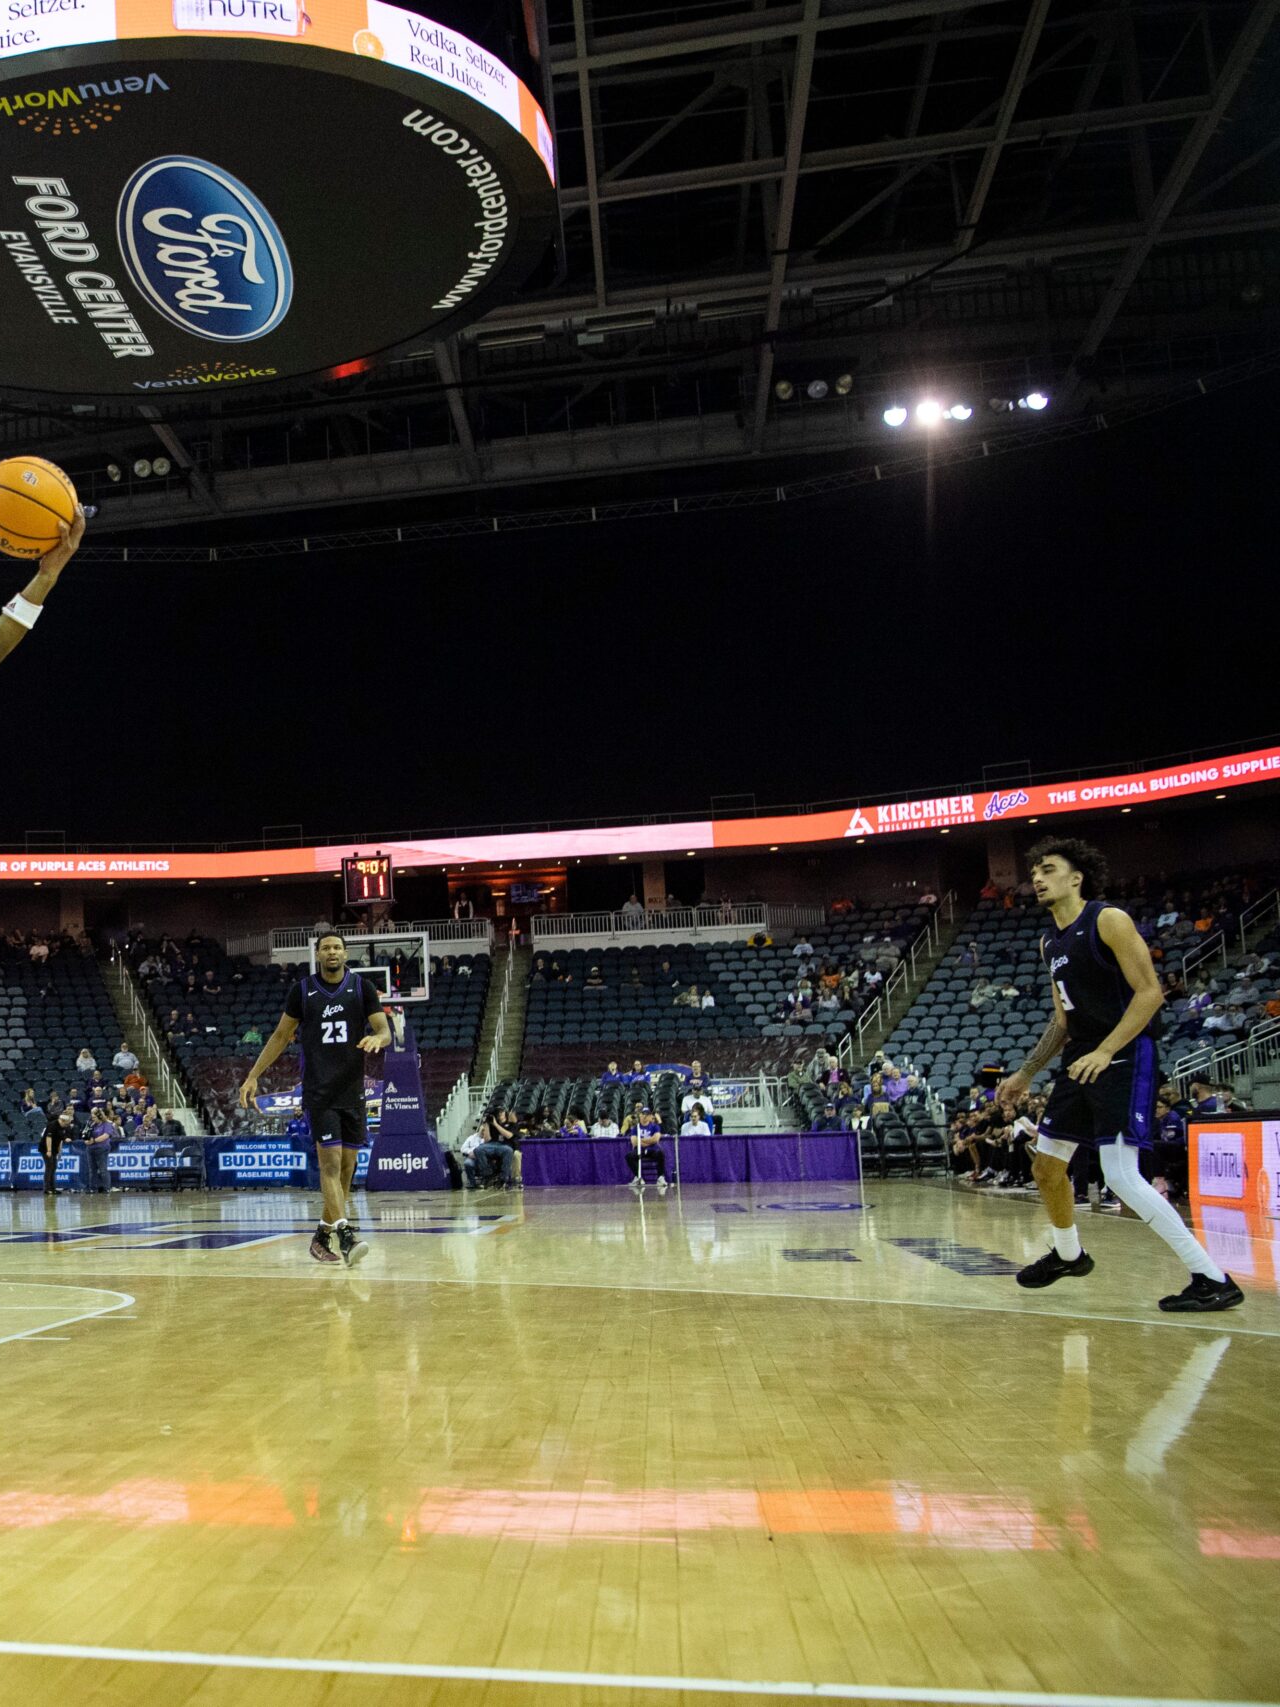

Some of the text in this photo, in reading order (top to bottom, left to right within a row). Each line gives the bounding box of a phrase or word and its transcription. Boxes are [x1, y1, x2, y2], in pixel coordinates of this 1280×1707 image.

[407, 18, 508, 89] Vodka. Seltzer.
[409, 45, 487, 97] Real Juice.
[402, 108, 508, 310] www.fordcenter.com
[11, 175, 155, 359] FORD CENTER
[142, 206, 265, 315] Ford
[132, 367, 277, 390] VenuWorks
[1048, 756, 1280, 805] THE OFFICIAL BUILDING SUPPLIE
[877, 794, 975, 824] KIRCHNER
[878, 814, 976, 833] BUILDING CENTERS
[10, 861, 27, 872] OF
[30, 861, 74, 872] PURPLE
[77, 861, 106, 871] ACES
[109, 860, 170, 871] ATHLETICS
[357, 859, 388, 874] 9:01
[363, 875, 384, 898] 11
[322, 1004, 344, 1019] Aces
[321, 1021, 348, 1044] 23
[20, 1158, 78, 1170] BUD GHT
[108, 1155, 139, 1168] BUD
[222, 1154, 303, 1167] BUD LIGHT
[378, 1153, 429, 1174] meijer
